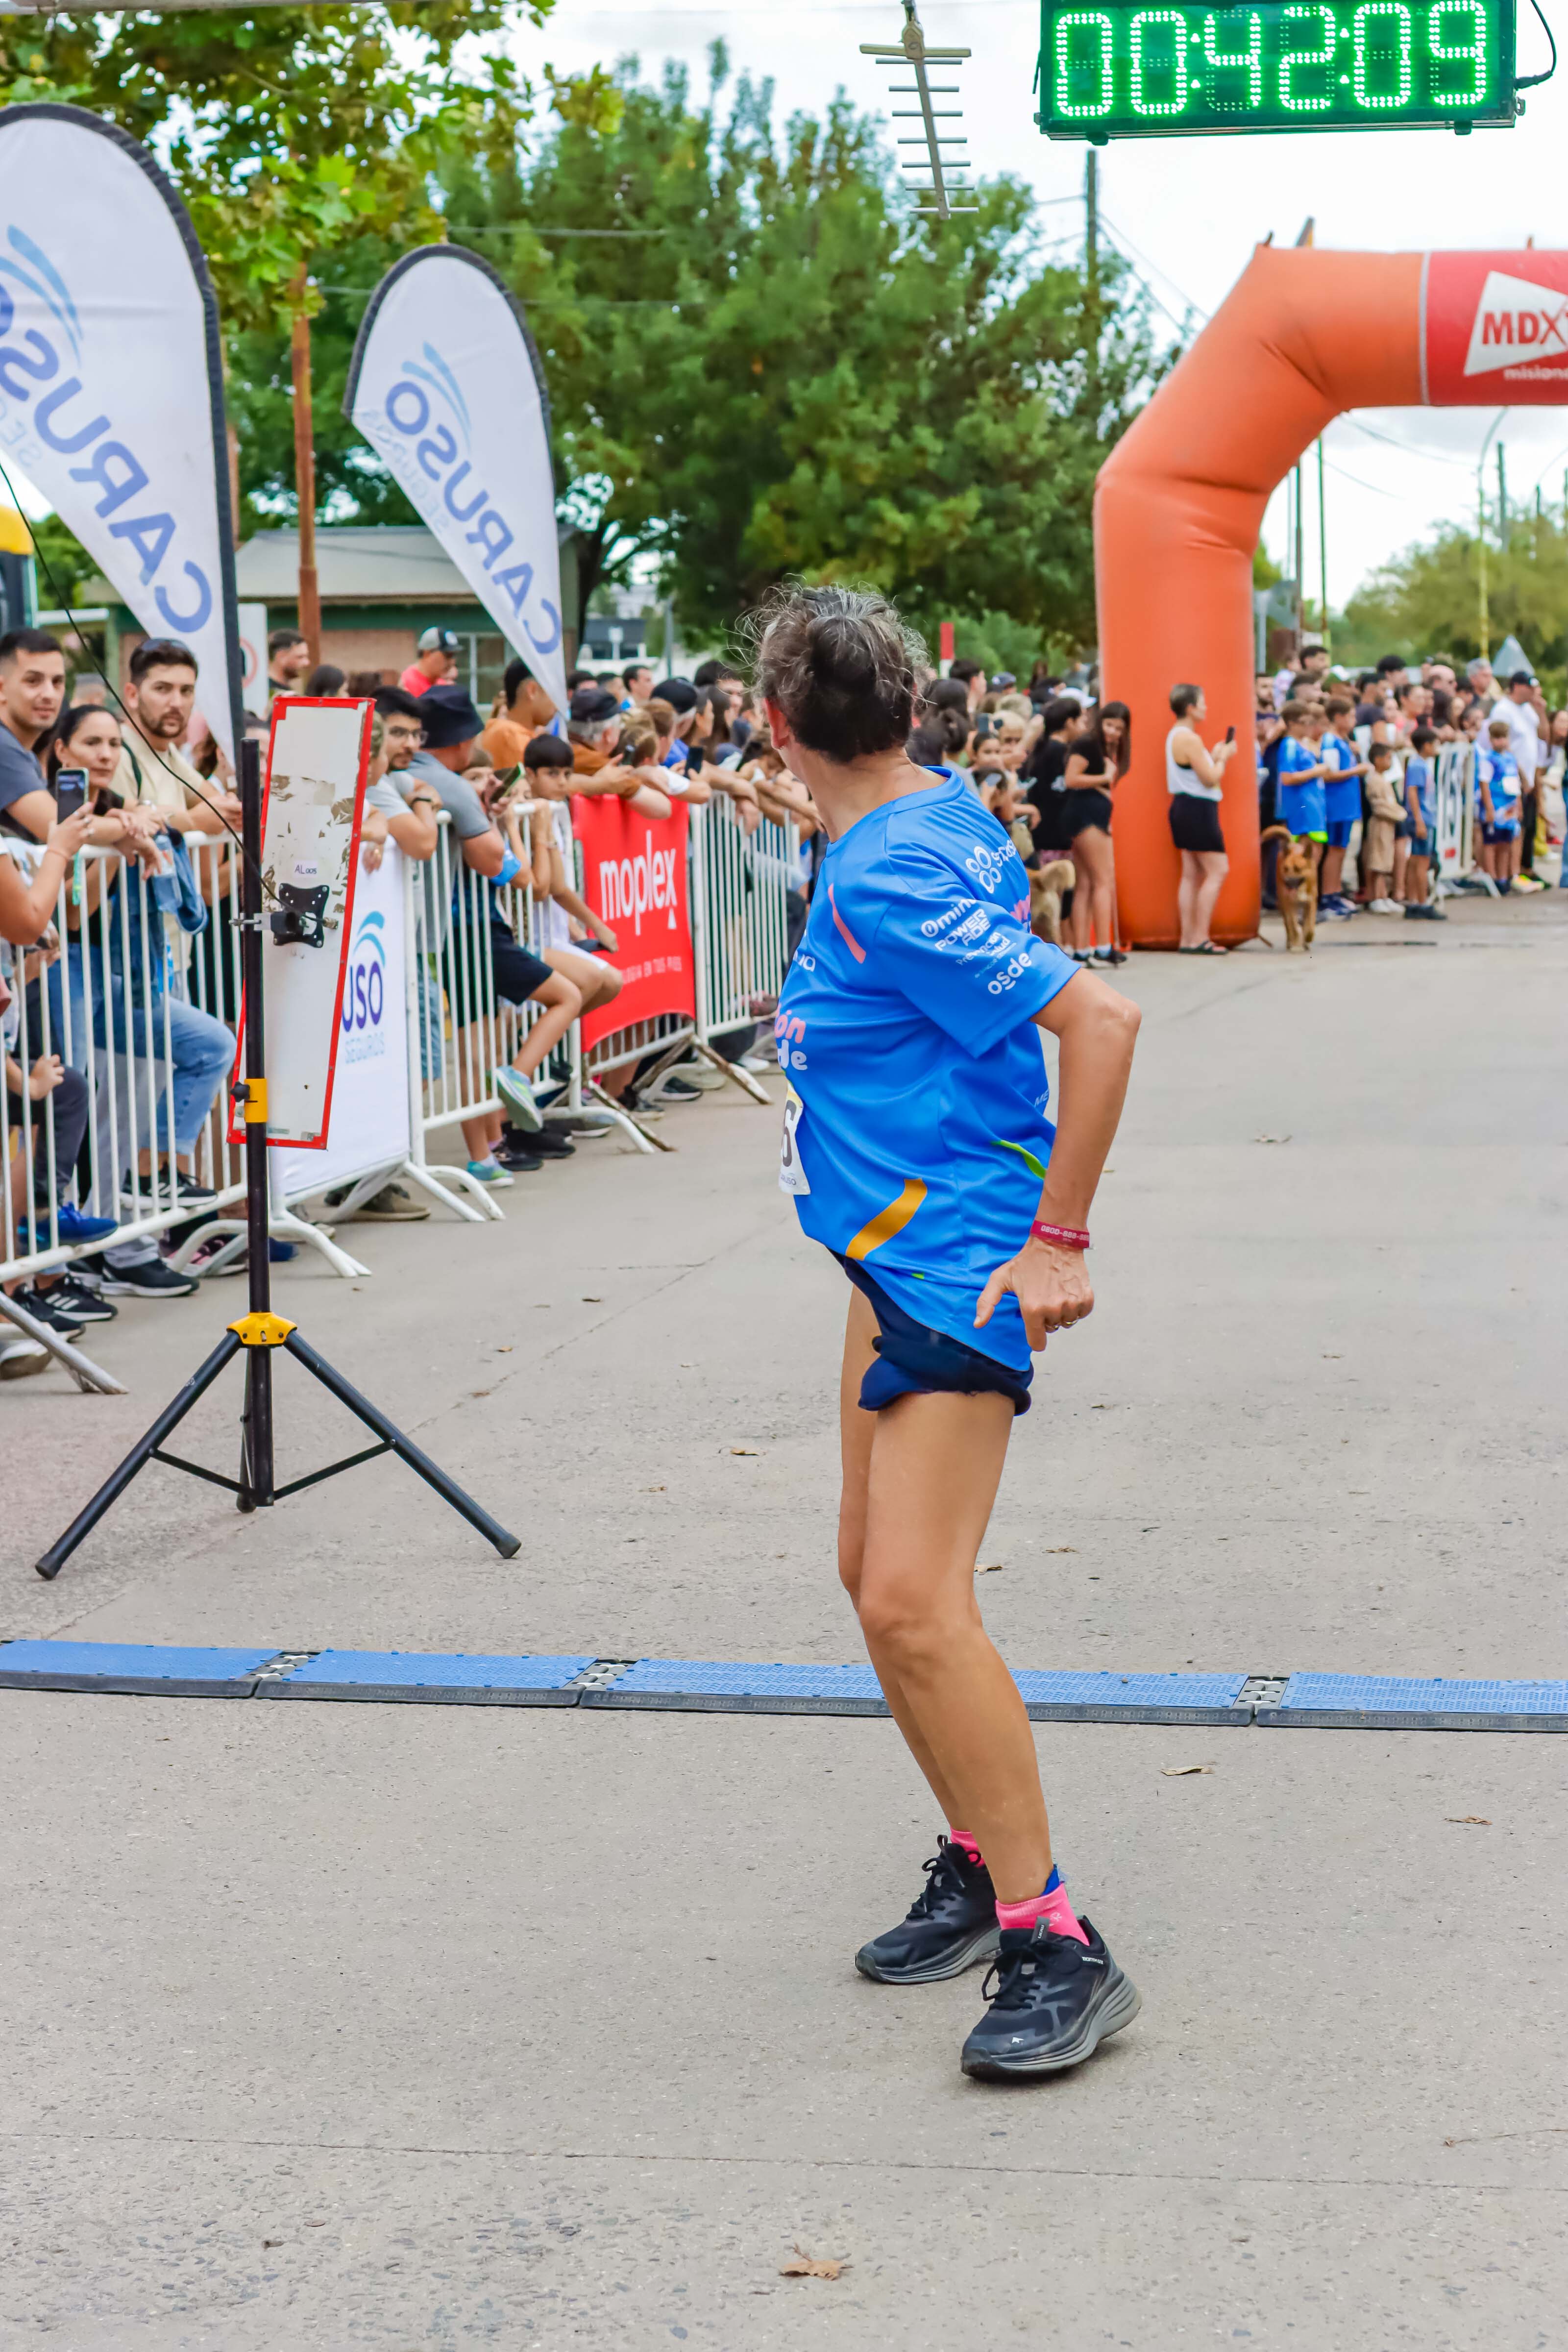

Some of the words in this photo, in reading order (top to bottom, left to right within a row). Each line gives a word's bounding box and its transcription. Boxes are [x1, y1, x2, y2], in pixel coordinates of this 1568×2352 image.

[1055, 0, 1487, 117] 00:42:09
[1482, 309, 1568, 349] MDX
[599, 829, 677, 936] moplex
[921, 899, 977, 938] Omin
[934, 908, 986, 952] POWER
[961, 917, 991, 946] ADE
[987, 953, 1032, 995] osde
[342, 961, 383, 1032] USO
